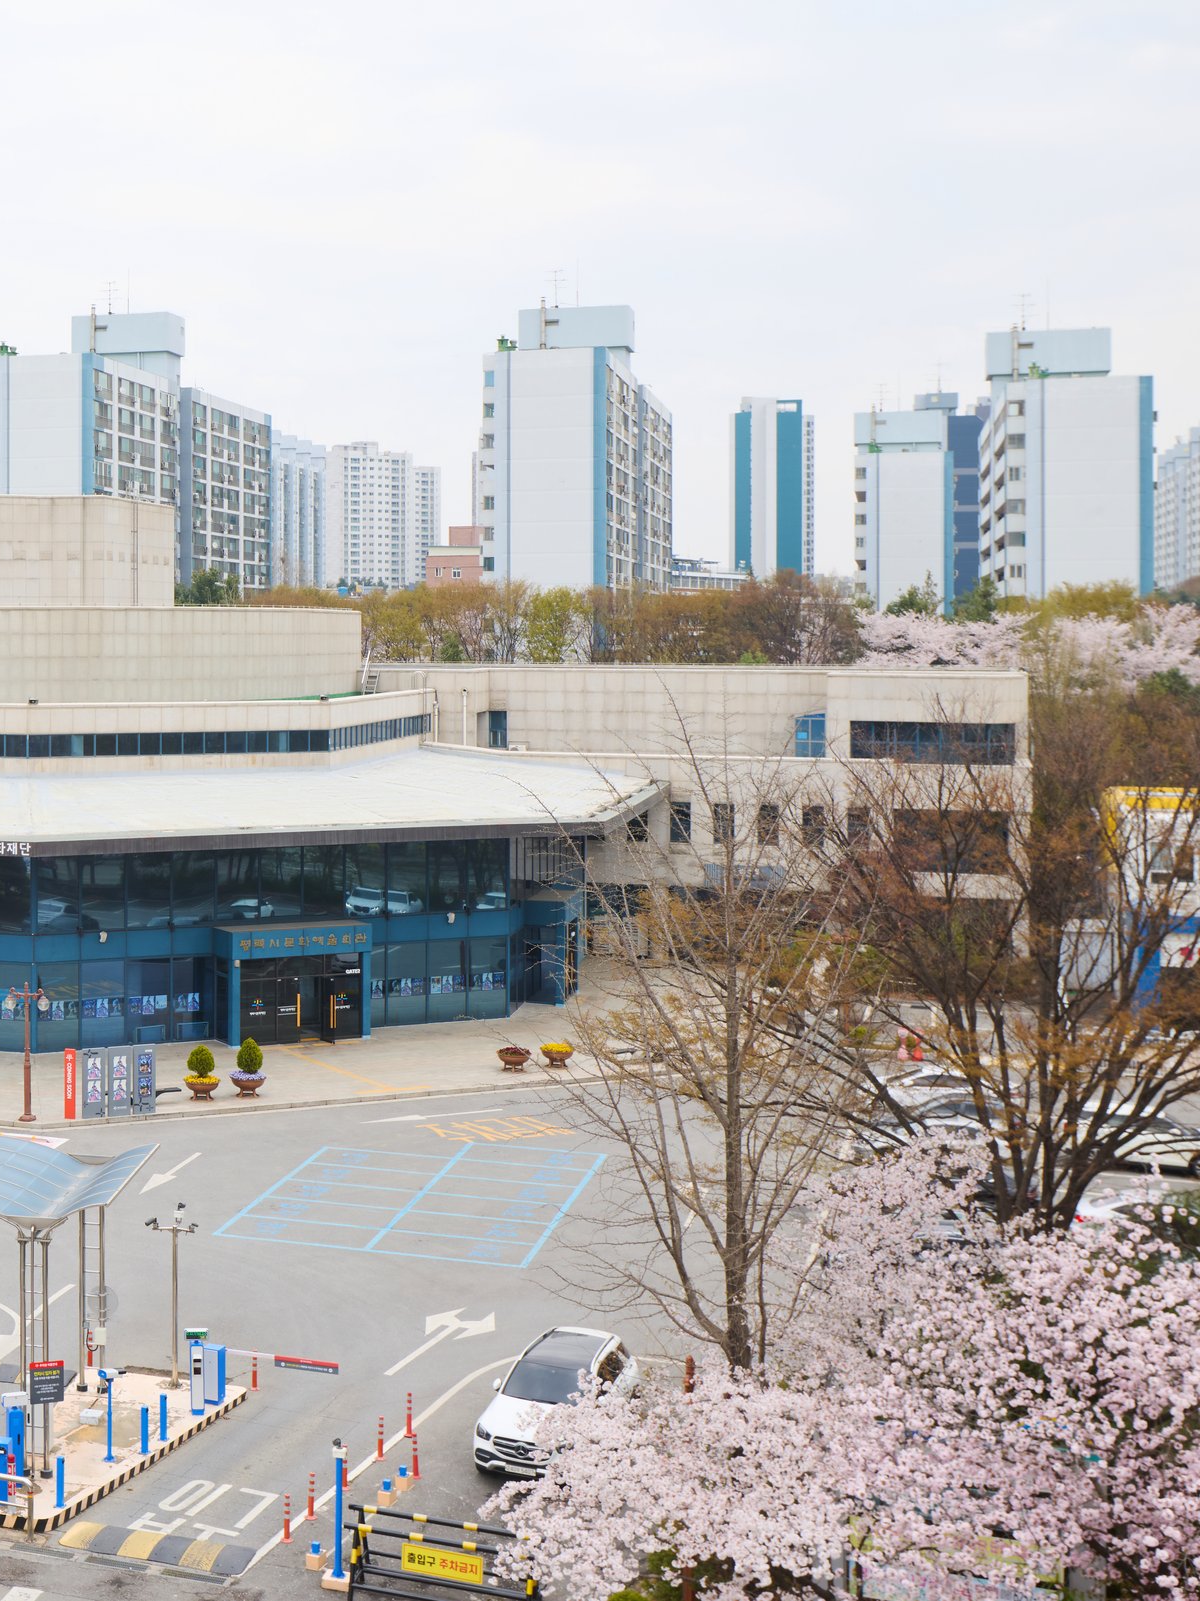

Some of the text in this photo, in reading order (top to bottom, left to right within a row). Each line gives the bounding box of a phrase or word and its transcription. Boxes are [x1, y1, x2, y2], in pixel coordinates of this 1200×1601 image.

[239, 932, 367, 951] 평택시문화예술회관
[126, 1479, 280, 1541] 입구
[407, 1552, 478, 1576] 출입구 주차금지
